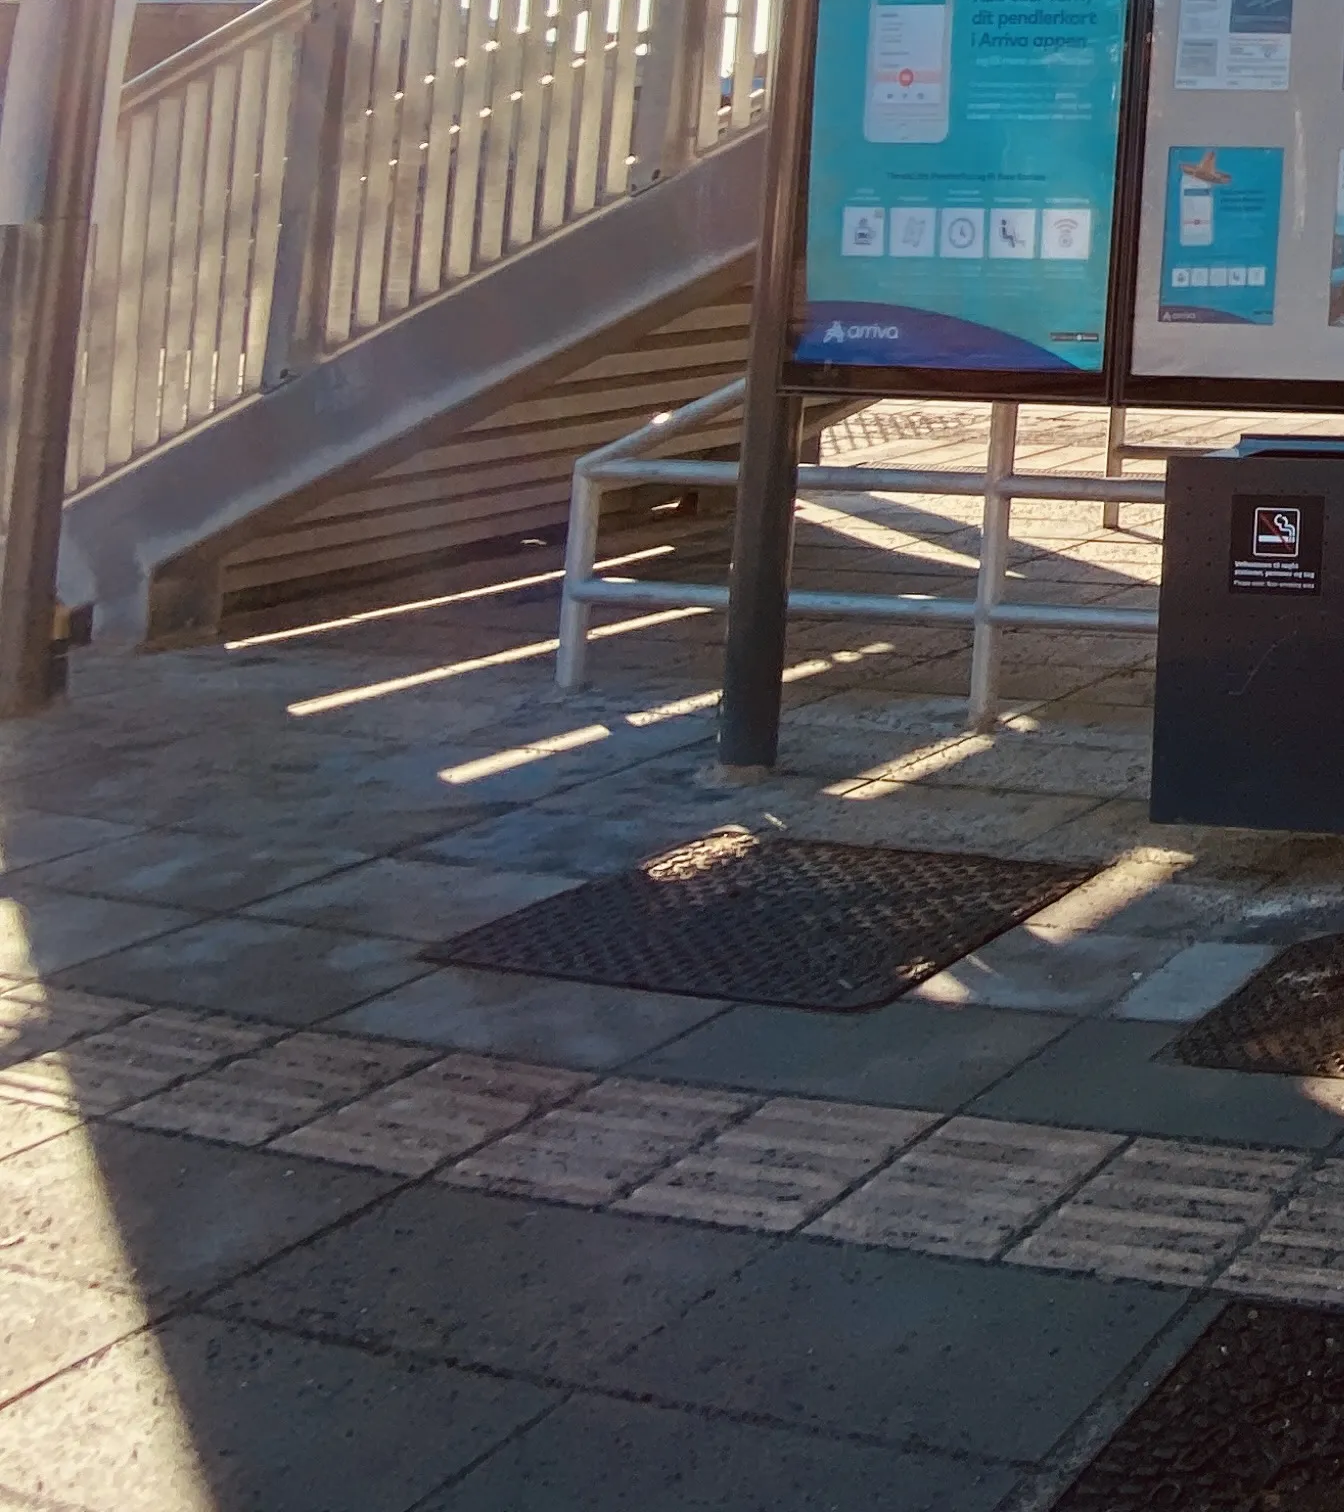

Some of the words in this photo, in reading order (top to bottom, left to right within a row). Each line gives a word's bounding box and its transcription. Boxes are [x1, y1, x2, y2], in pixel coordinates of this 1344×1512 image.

[972, 9, 994, 25] dit
[998, 9, 1097, 29] pendlerkort
[971, 32, 975, 47] i
[979, 32, 1028, 47] Arriva
[847, 323, 899, 339] arriva
